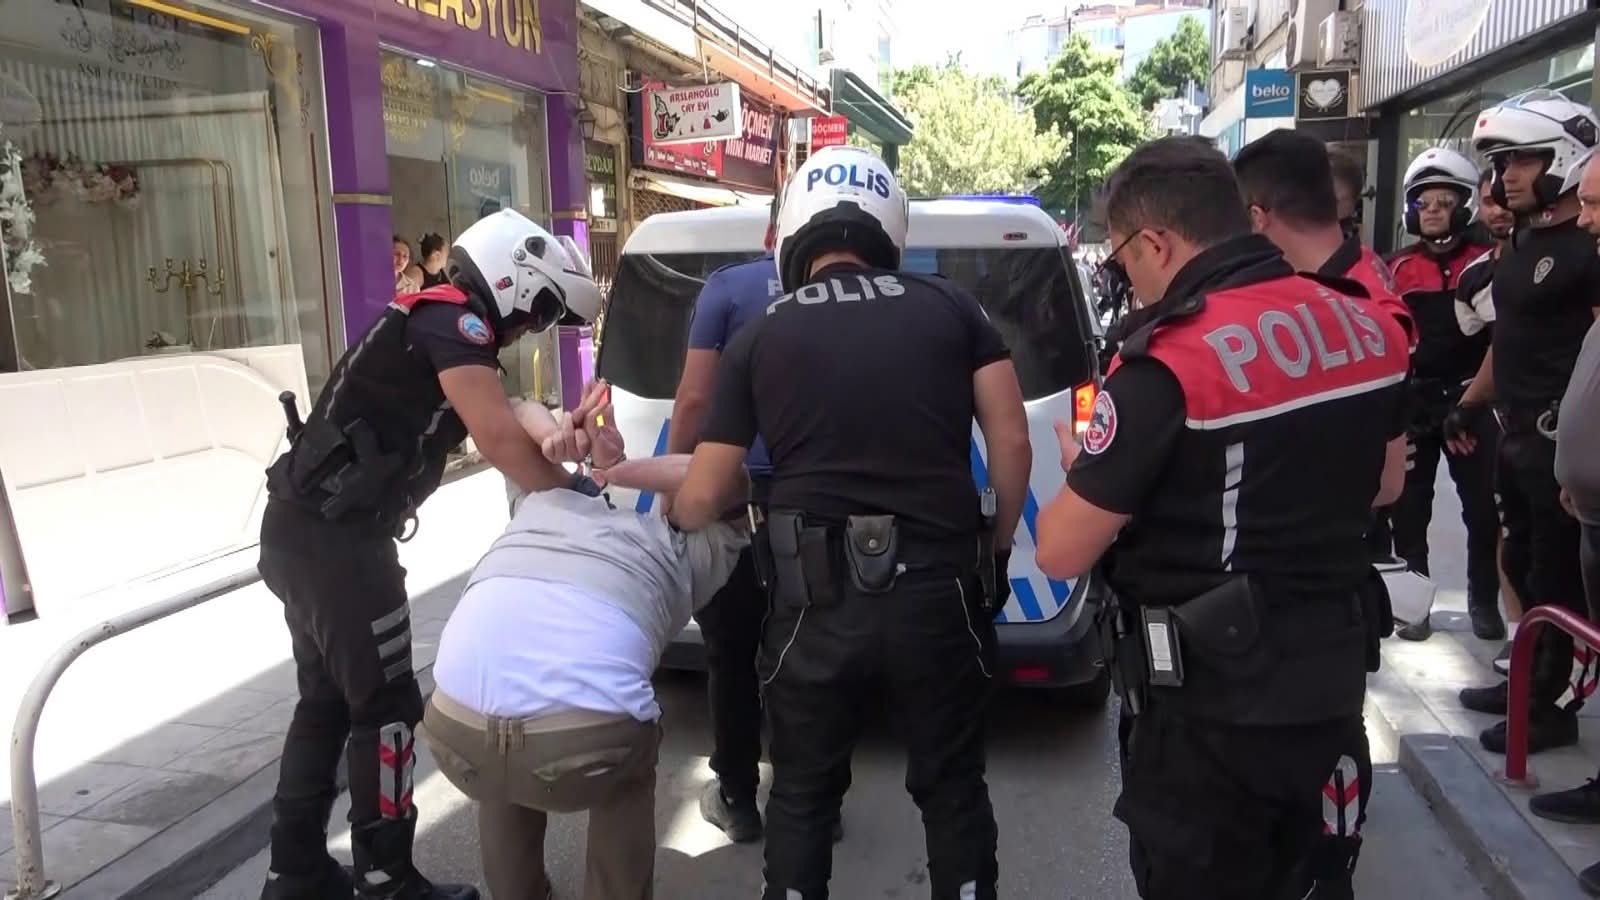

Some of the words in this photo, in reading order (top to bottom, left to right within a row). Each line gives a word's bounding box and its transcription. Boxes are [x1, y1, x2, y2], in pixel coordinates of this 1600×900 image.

[396, 0, 541, 54] ASYON
[1252, 83, 1290, 97] beko
[741, 102, 774, 140] ÖÇMEN
[744, 142, 772, 165] MARKET
[1202, 286, 1386, 393] POLİS
